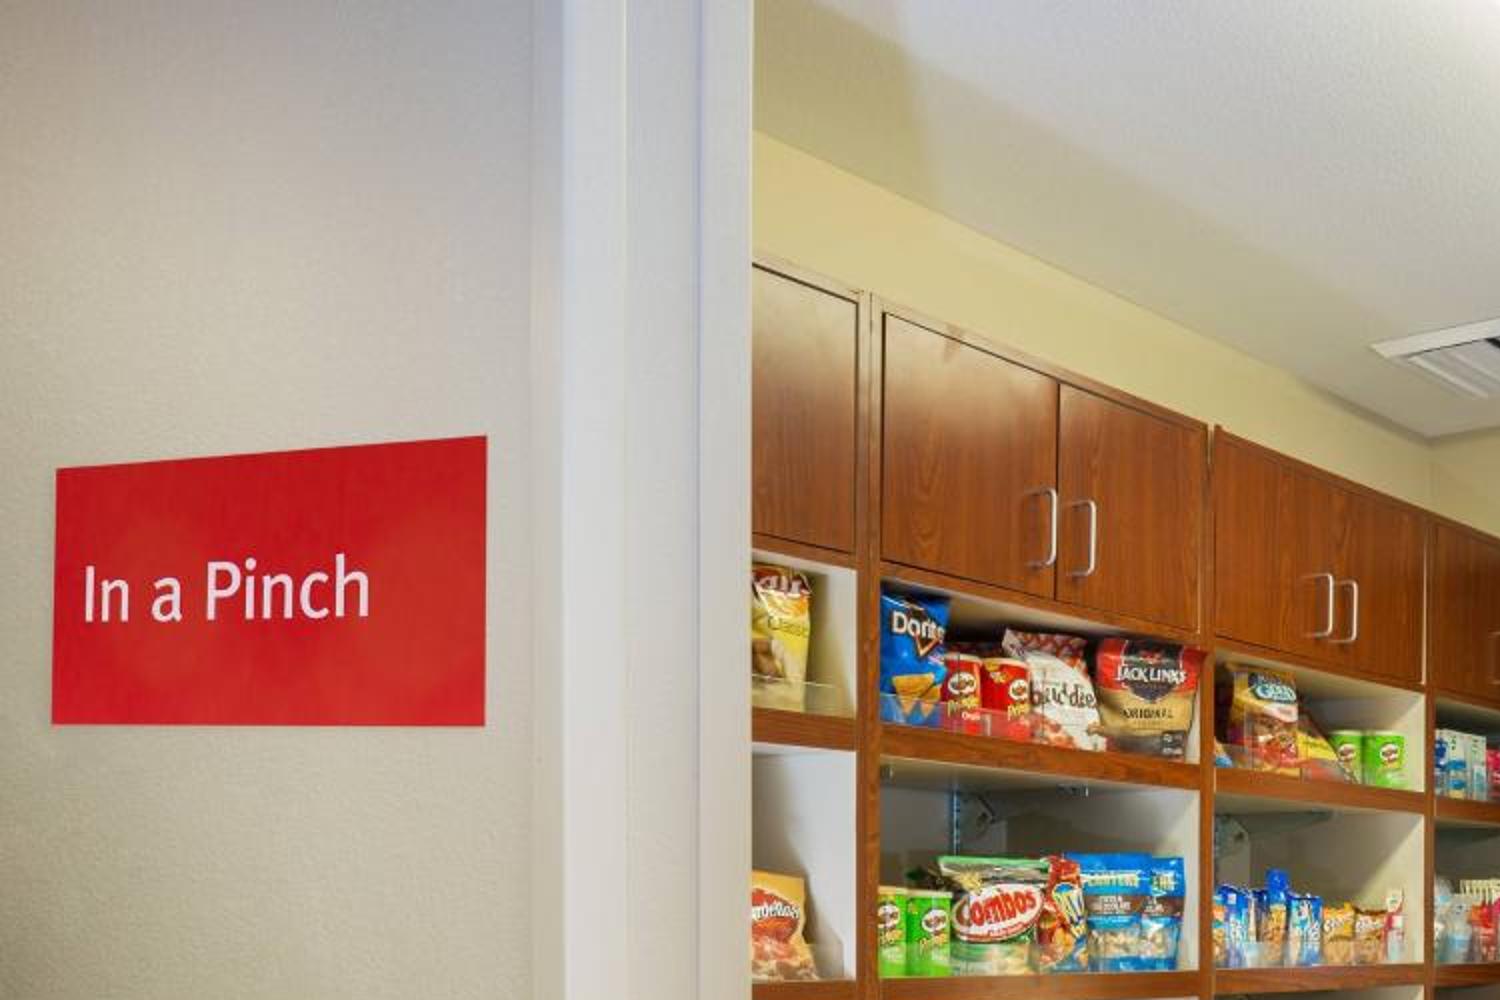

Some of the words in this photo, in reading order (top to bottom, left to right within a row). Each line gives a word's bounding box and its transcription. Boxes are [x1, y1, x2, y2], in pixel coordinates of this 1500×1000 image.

[84, 565, 129, 623] In
[151, 576, 183, 623] a
[206, 552, 370, 621] Pinch
